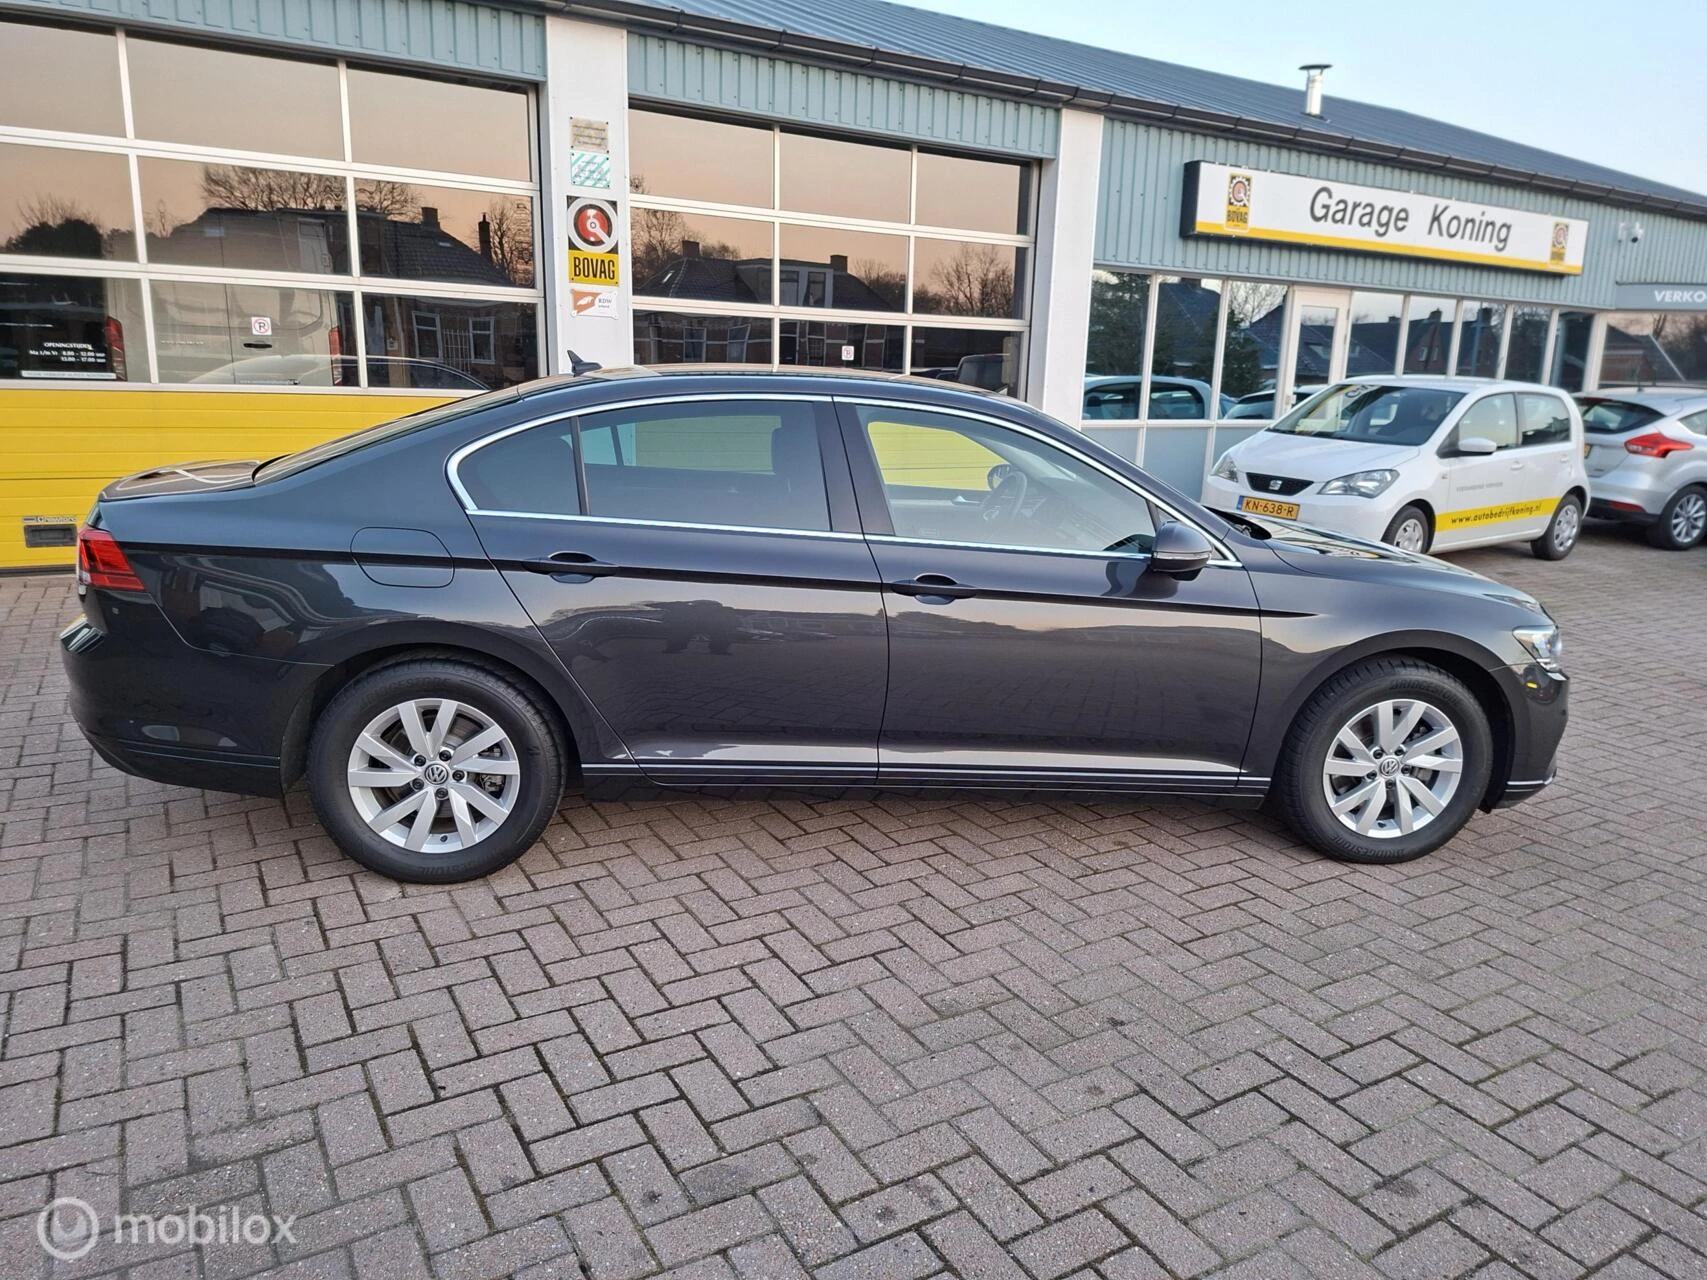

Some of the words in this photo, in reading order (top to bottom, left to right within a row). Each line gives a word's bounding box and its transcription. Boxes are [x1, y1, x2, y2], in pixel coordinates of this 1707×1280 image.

[1227, 209, 1248, 224] BOVAG
[1309, 186, 1410, 238] Garage
[1427, 203, 1512, 252] Koning
[573, 256, 616, 280] BOVAG
[1654, 289, 1707, 303] VERKO
[1245, 499, 1295, 517] KN-638-R
[1451, 502, 1542, 524] www.autobedrijfkoning.nl
